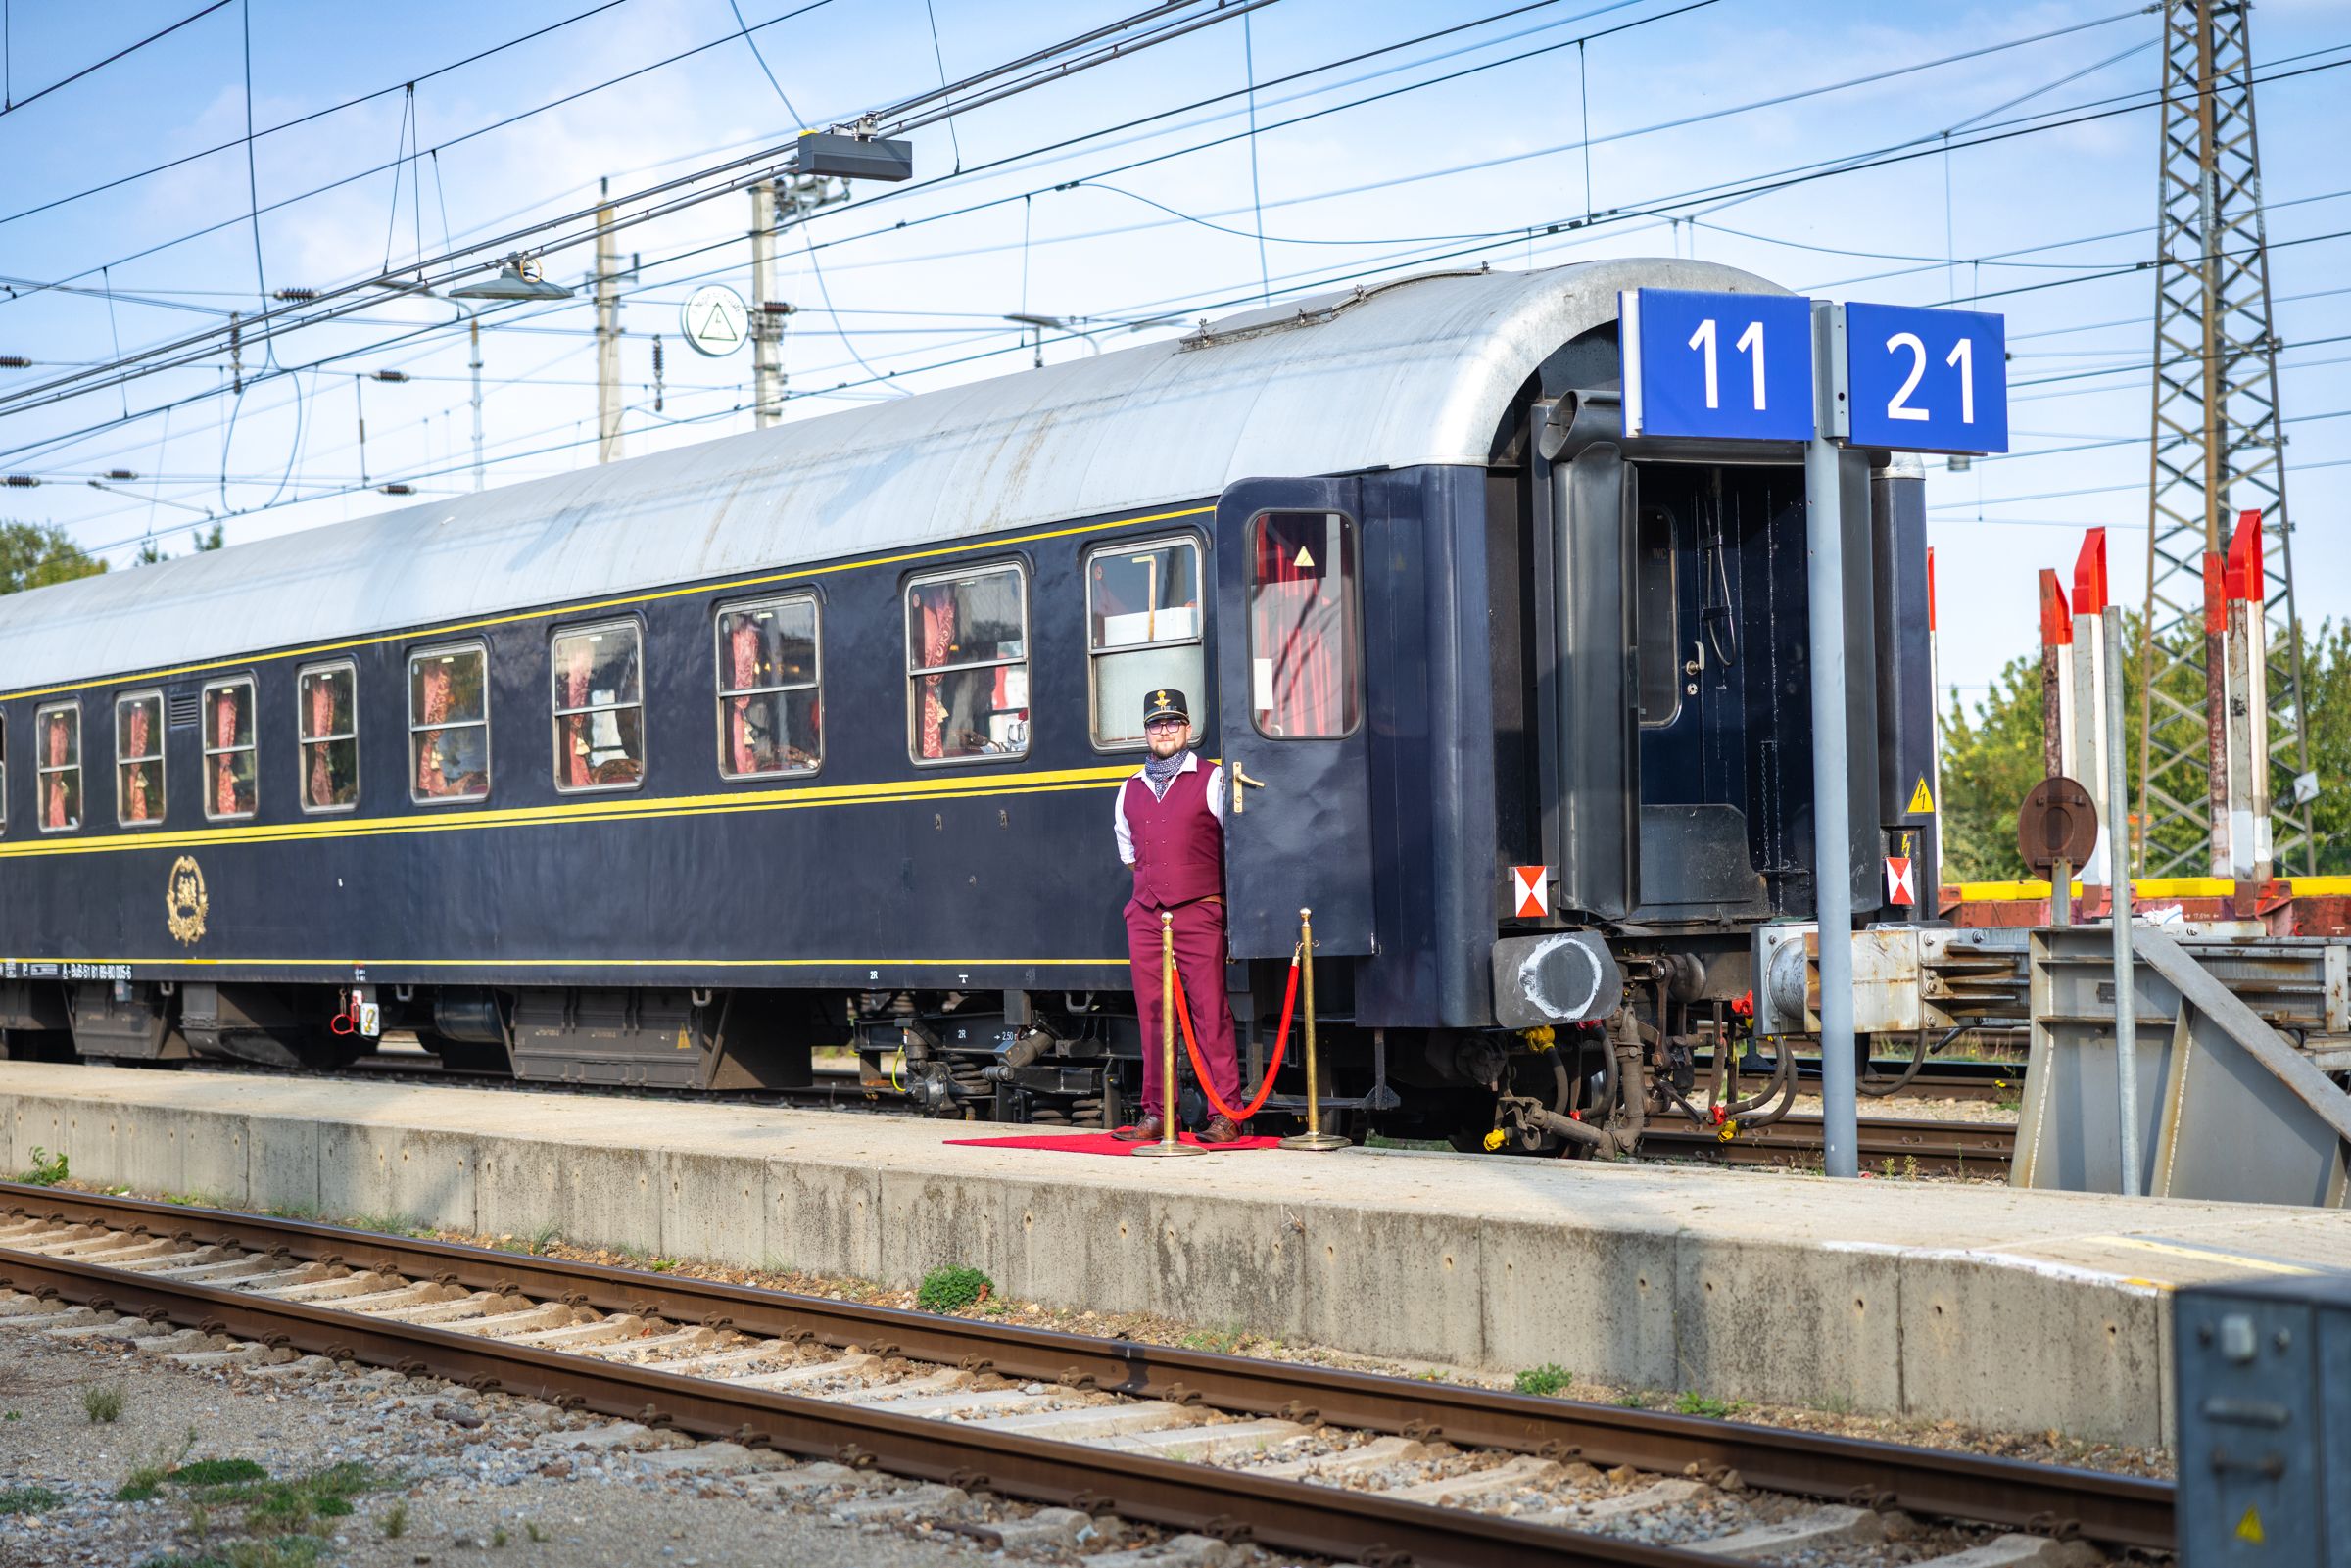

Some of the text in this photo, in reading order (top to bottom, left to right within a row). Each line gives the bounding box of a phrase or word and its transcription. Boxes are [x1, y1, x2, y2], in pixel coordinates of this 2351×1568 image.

[1688, 319, 1766, 410] 11
[1885, 332, 1974, 424] 21
[1652, 547, 1668, 561] WC
[870, 970, 878, 980] 2R
[958, 1029, 966, 1039] 2R
